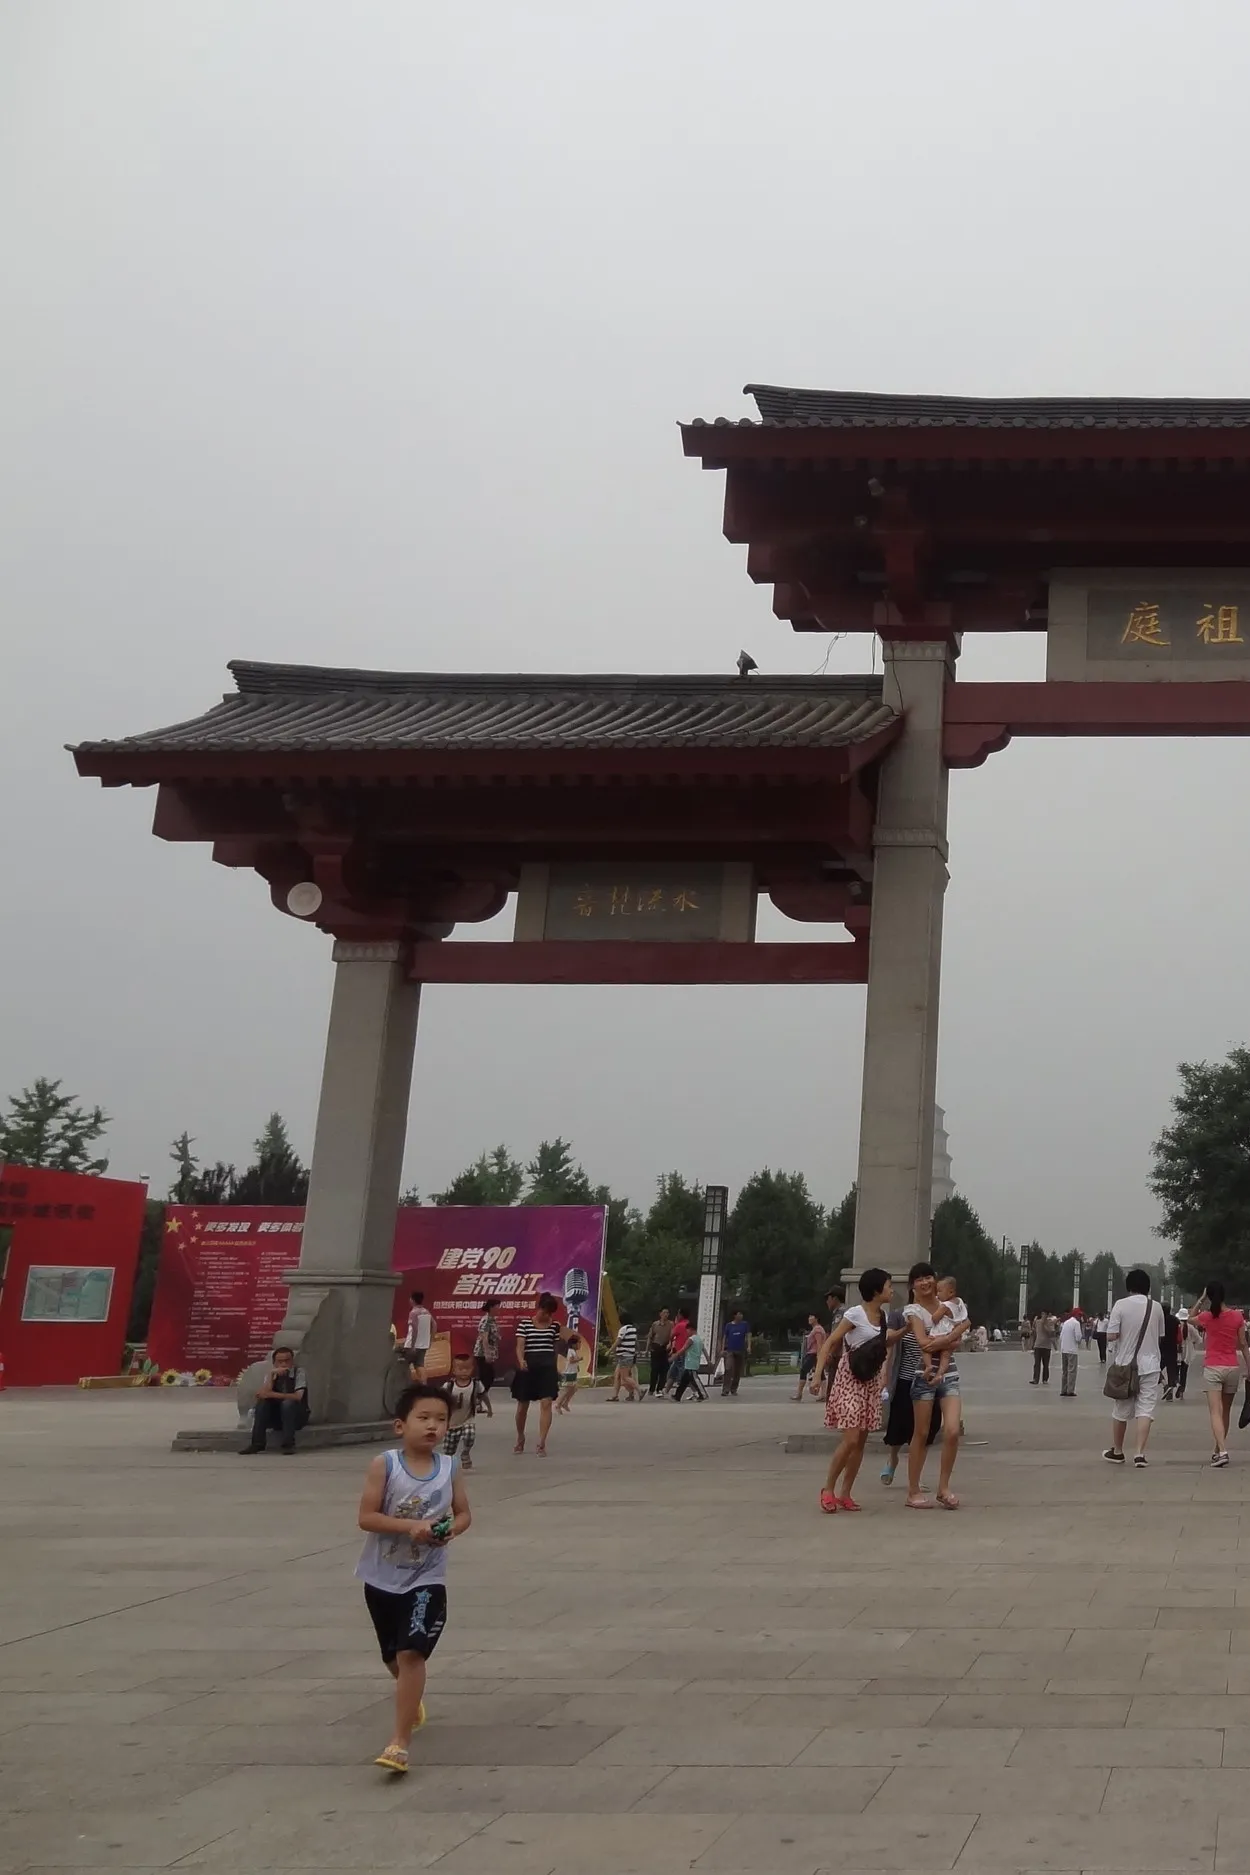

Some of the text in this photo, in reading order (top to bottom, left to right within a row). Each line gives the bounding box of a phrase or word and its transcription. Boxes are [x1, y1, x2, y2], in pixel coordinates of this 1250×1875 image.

[436, 1246, 517, 1270] 建党90
[452, 1273, 544, 1295] 音乐曲江
